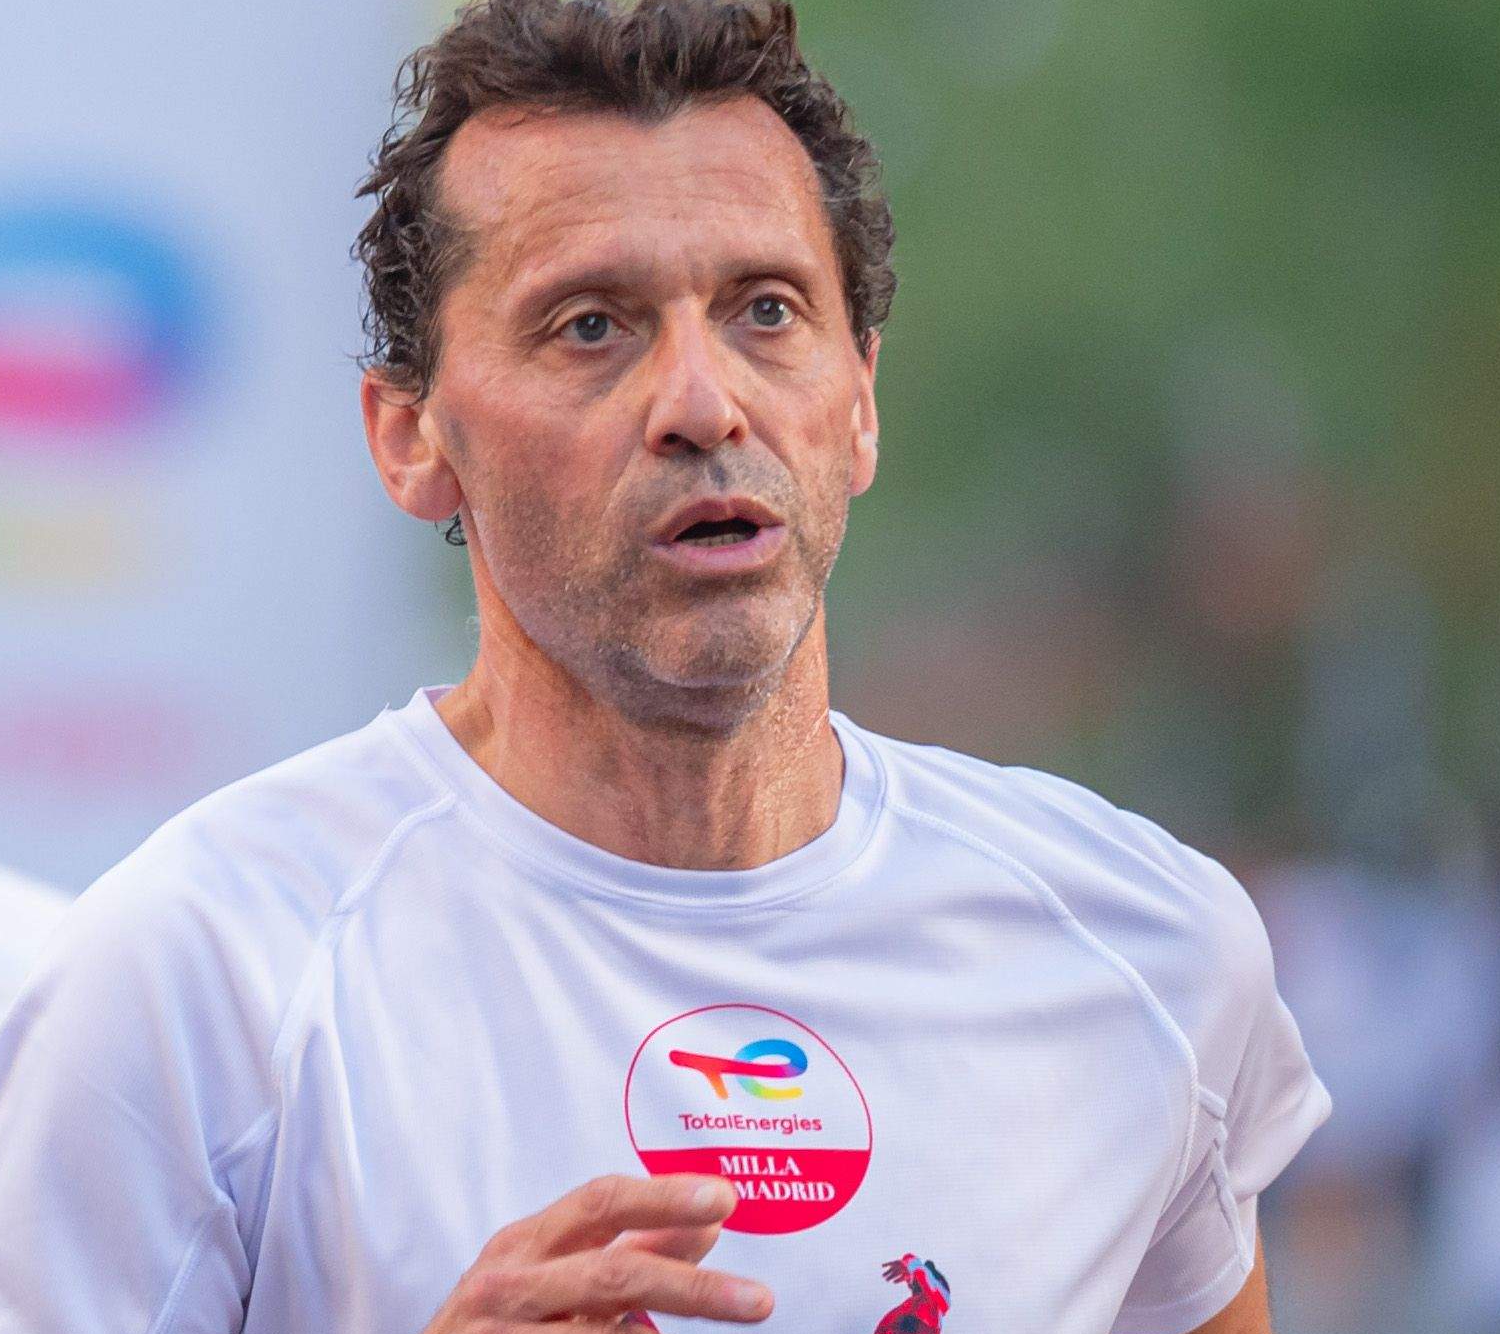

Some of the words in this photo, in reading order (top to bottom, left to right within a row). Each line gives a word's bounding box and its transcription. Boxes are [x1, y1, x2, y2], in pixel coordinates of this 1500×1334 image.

[678, 1112, 823, 1135] TotalEnergies
[718, 1154, 803, 1176] MILLA
[734, 1180, 836, 1202] MADRID
